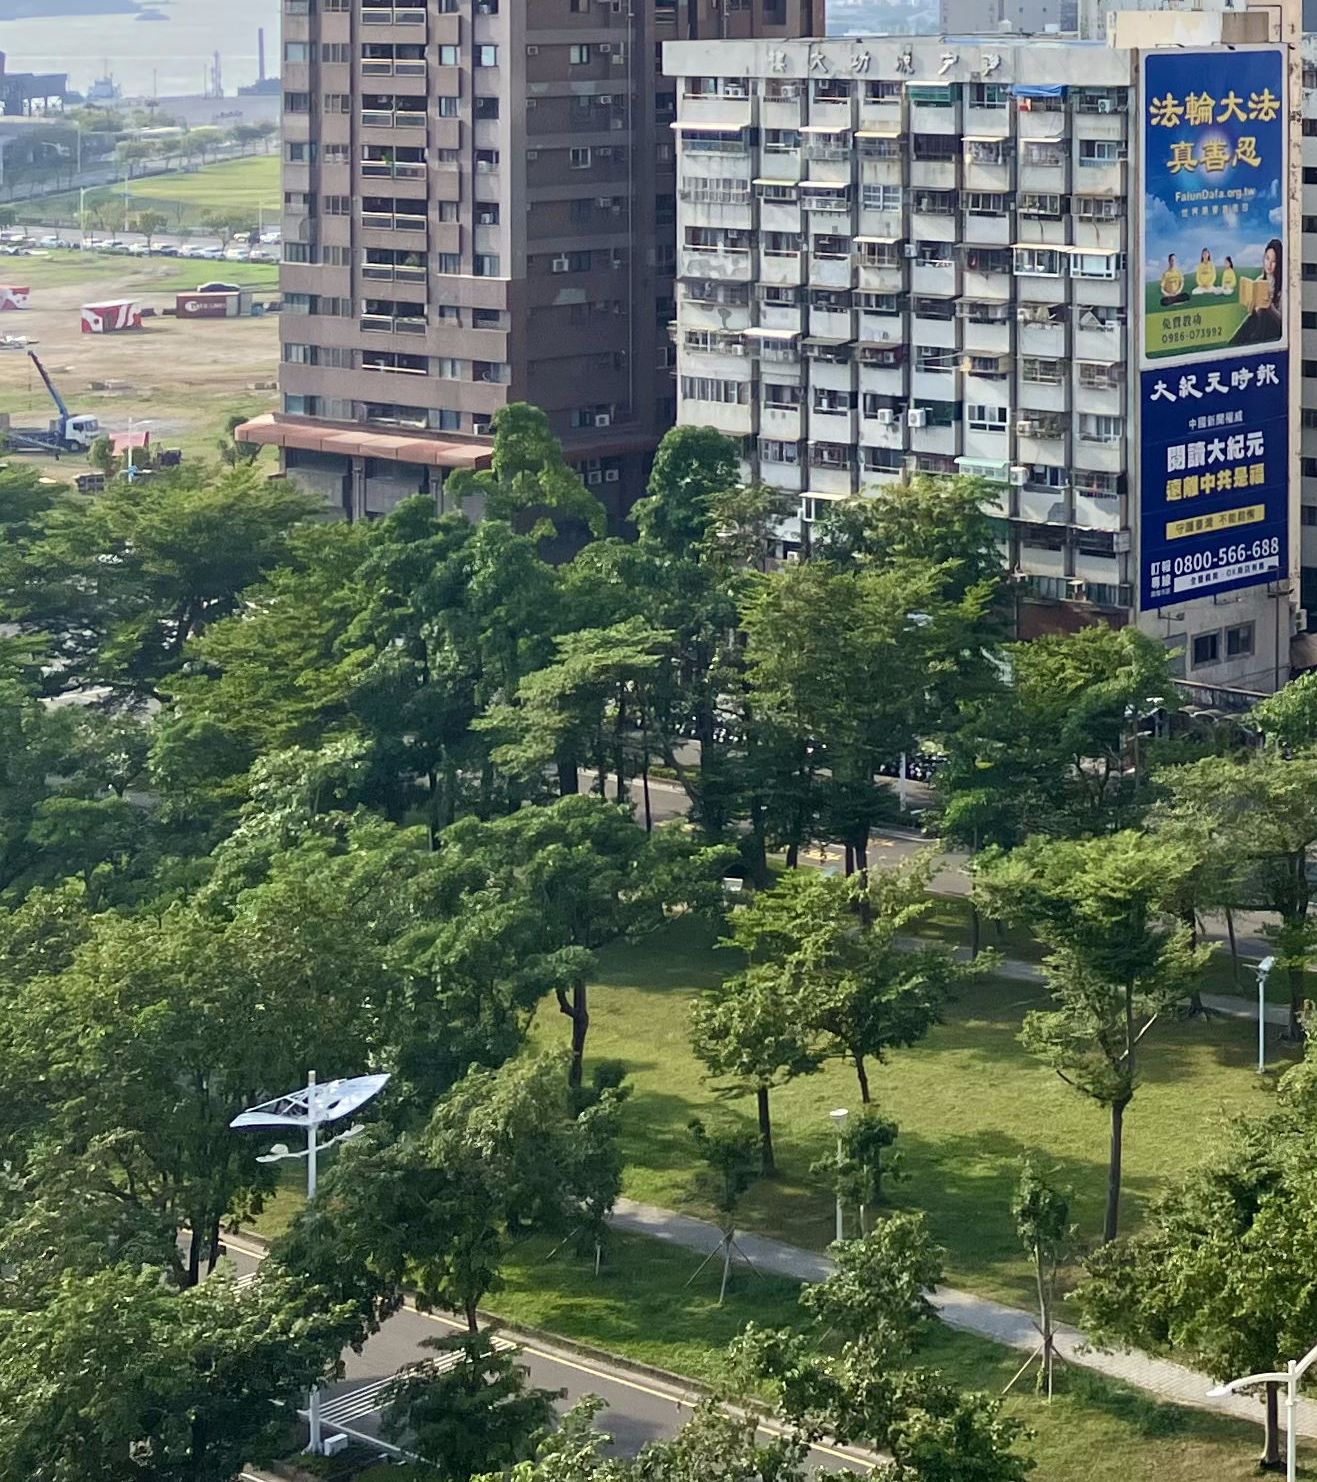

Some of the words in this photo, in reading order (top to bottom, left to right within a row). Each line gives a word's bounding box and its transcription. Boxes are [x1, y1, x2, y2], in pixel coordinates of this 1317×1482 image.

[1149, 88, 1281, 127] 法輪大法
[1166, 136, 1262, 174] 真善忍
[1175, 187, 1256, 203] FalunDafa.org.tw
[1162, 327, 1222, 344] 0986-073992
[1150, 364, 1280, 402] 大紀元時報
[1167, 431, 1265, 473] 閱讀大紀元
[1166, 463, 1265, 502] 遠離中共是福
[1174, 537, 1279, 575] 0800-566-688
